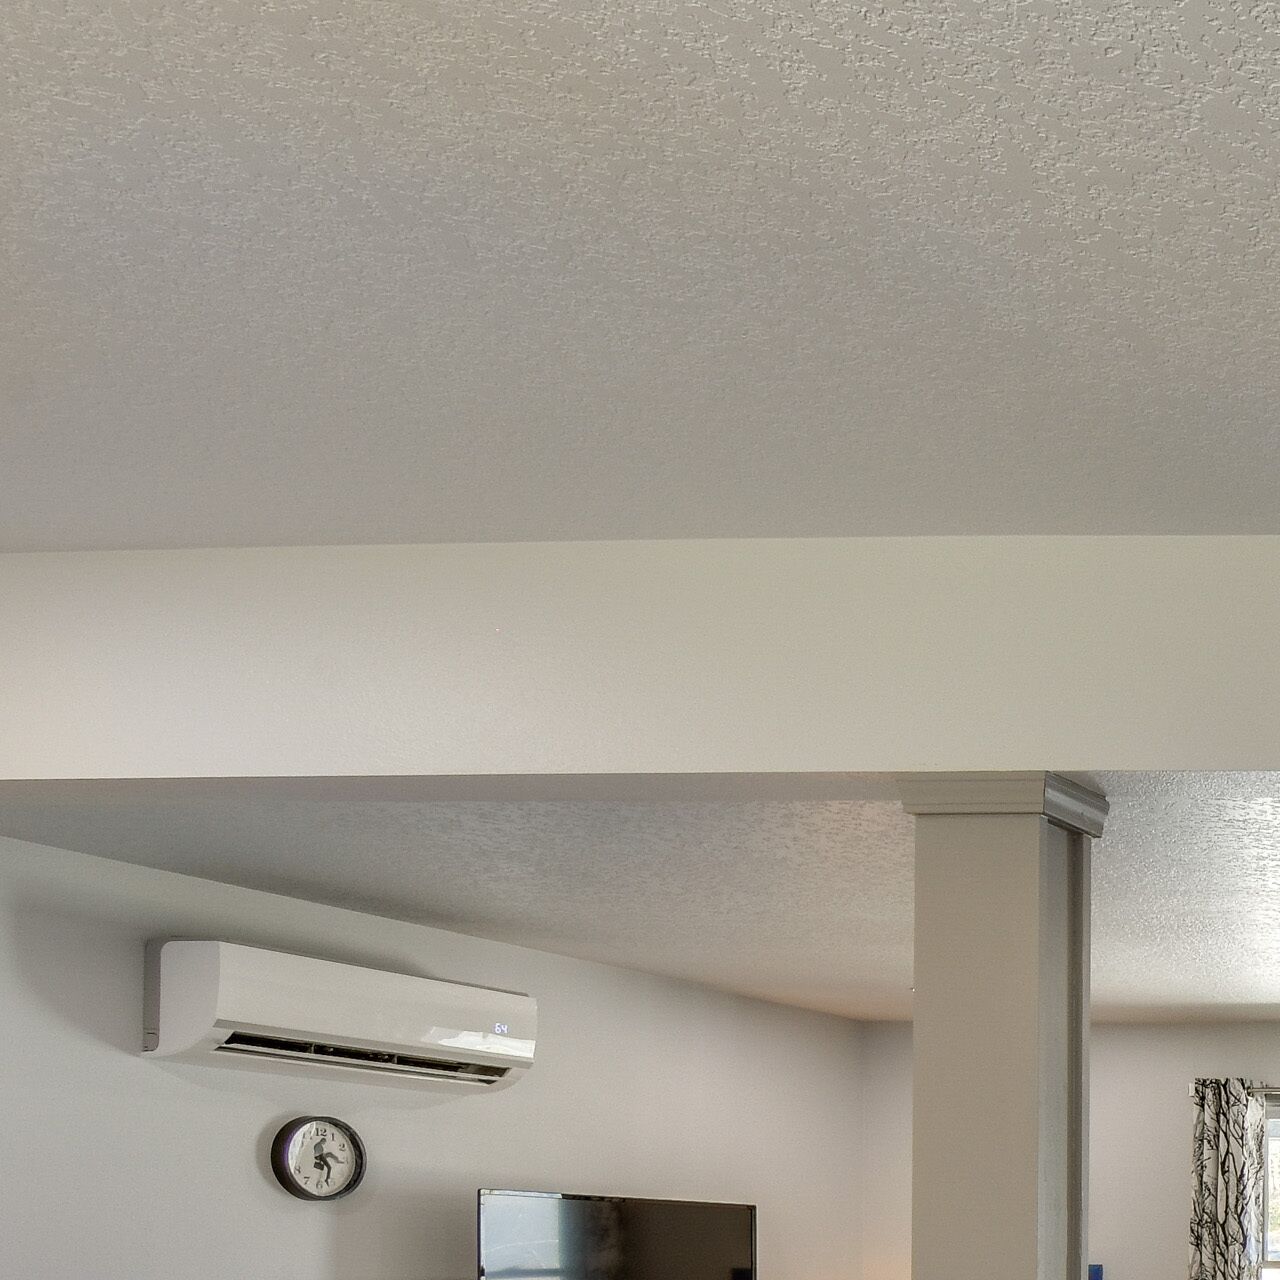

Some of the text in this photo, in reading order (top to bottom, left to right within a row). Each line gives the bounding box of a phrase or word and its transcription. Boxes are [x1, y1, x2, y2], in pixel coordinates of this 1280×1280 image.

[315, 1127, 327, 1137] 12
[339, 1143, 346, 1151] 2
[303, 1176, 310, 1185] 7
